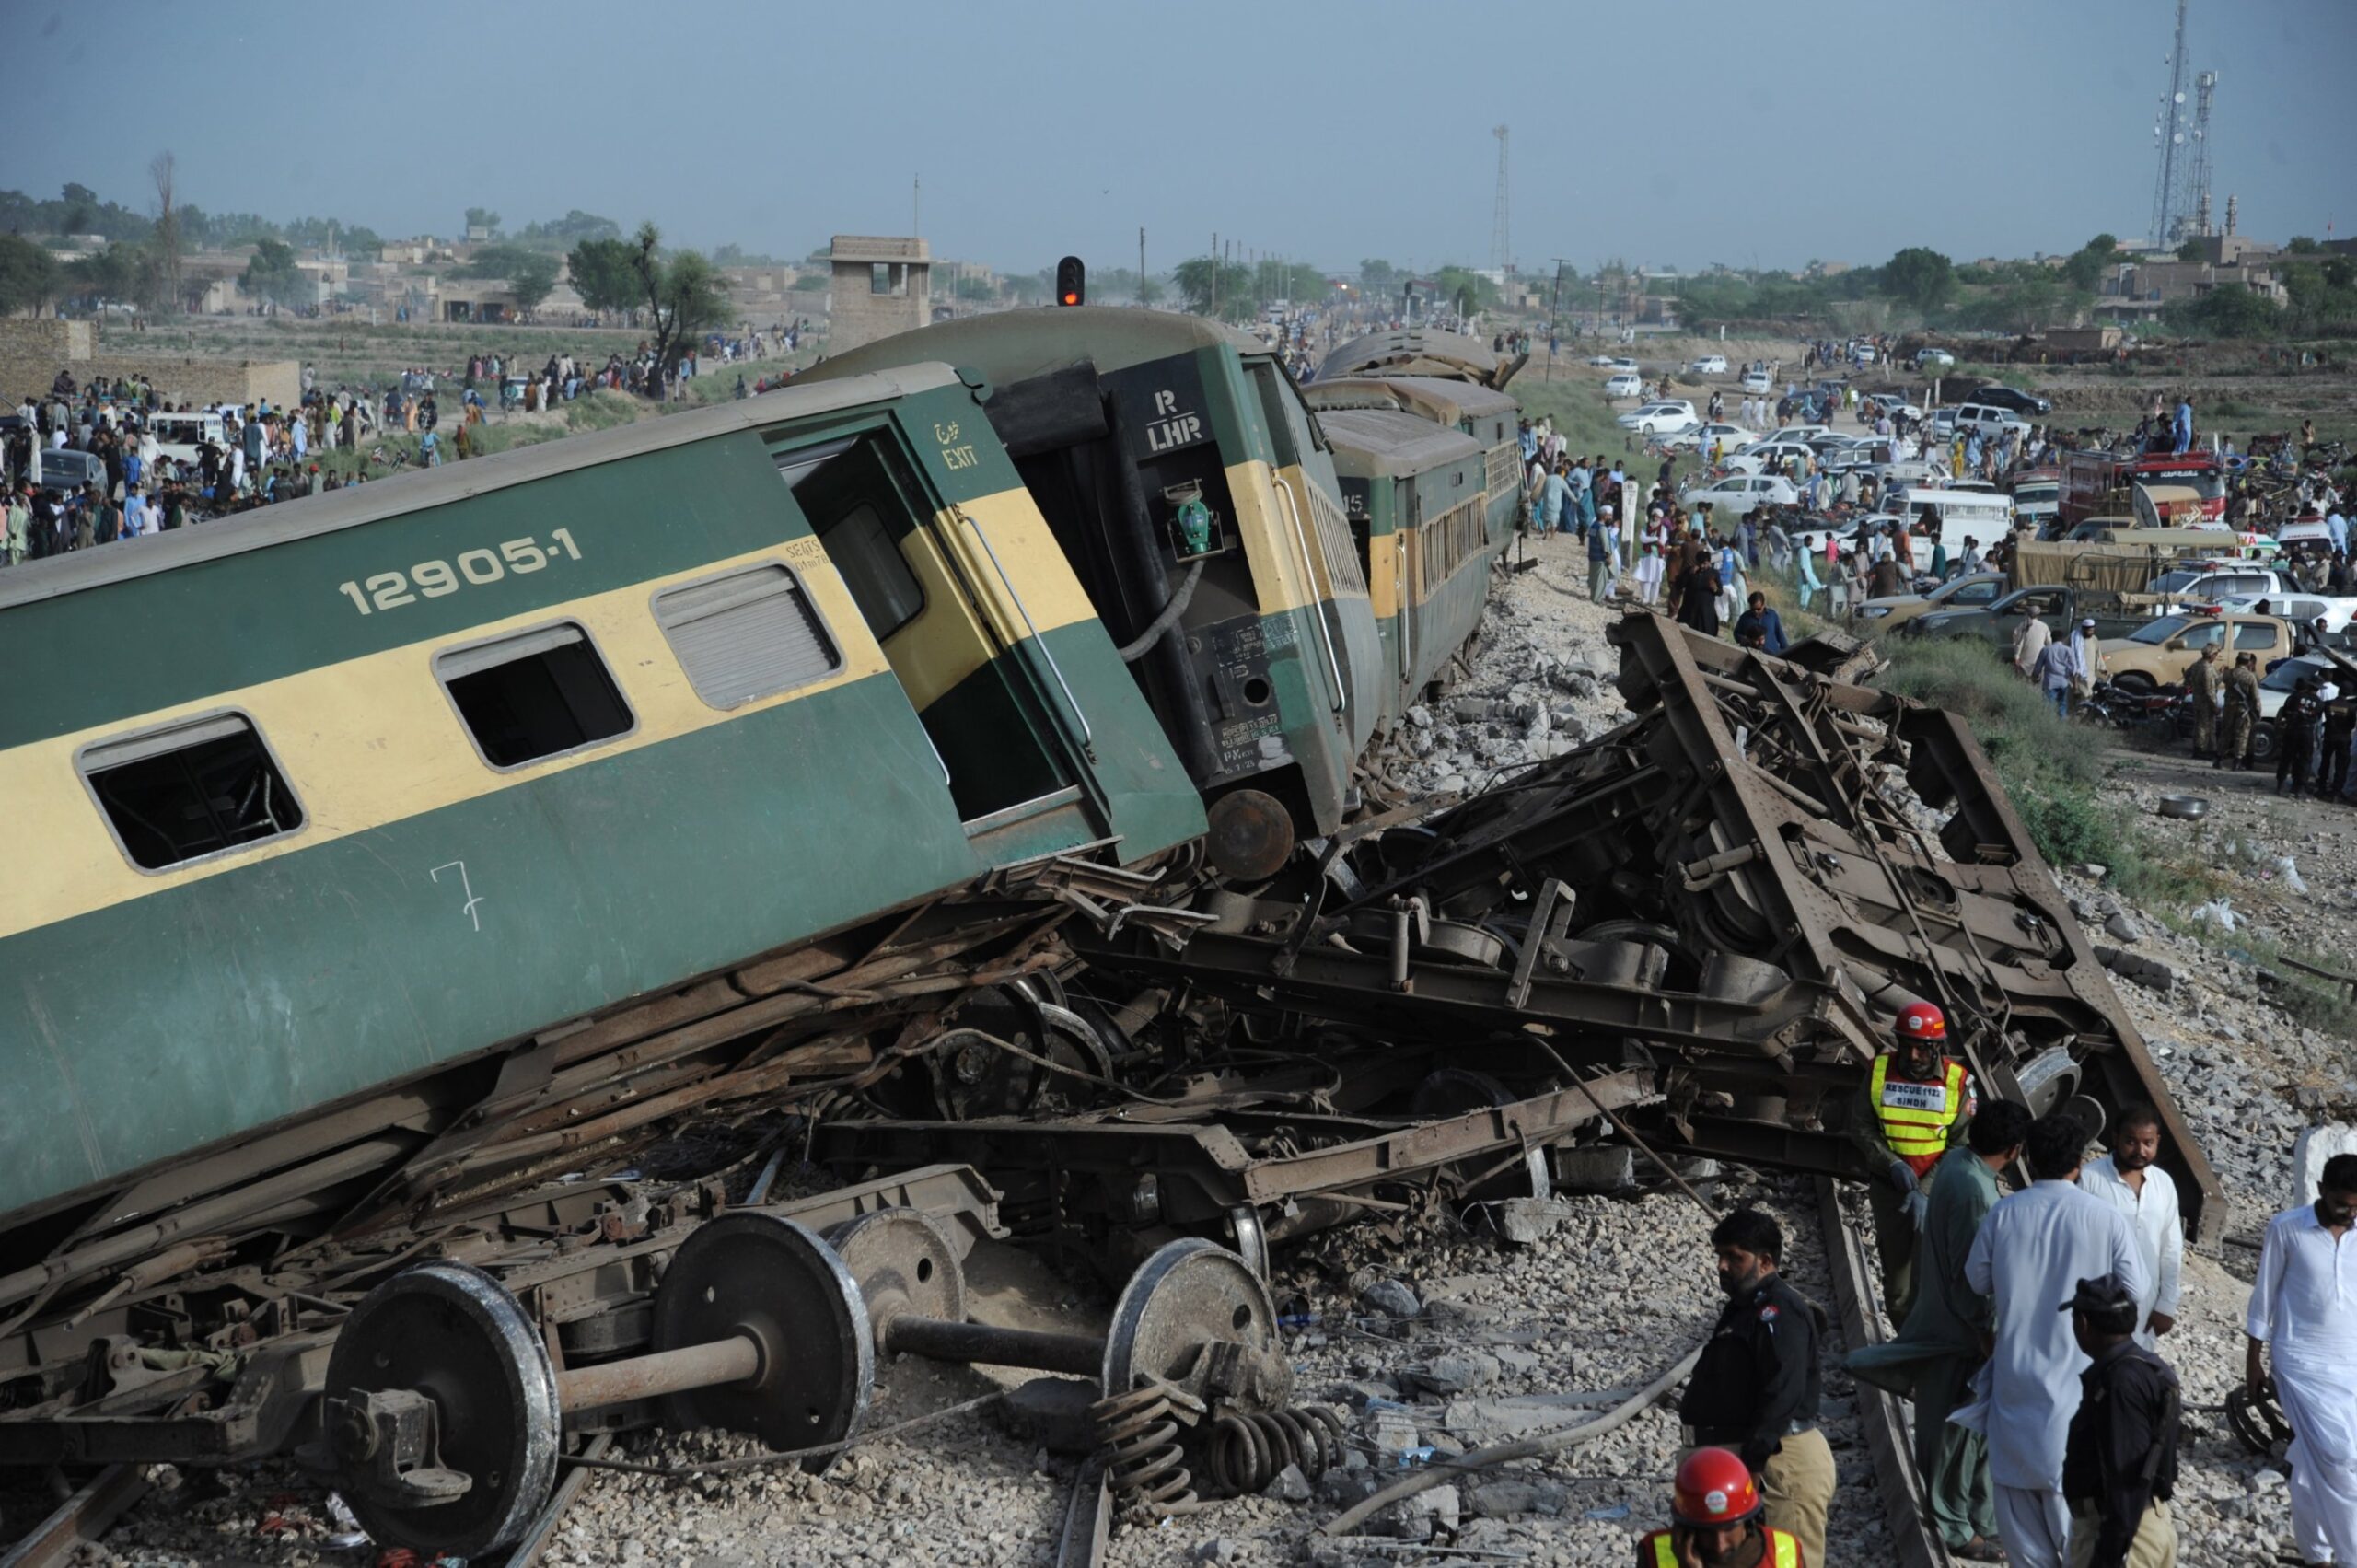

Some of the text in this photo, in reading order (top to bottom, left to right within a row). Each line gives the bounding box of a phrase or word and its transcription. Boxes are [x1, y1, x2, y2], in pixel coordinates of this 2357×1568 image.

[1154, 389, 1178, 416] R
[1146, 416, 1203, 452] LHR
[941, 444, 978, 470] EXIT
[785, 539, 821, 559] SEATS
[1886, 1083, 1941, 1098] RESCUE 1122
[1897, 1097, 1927, 1109] SINDH
